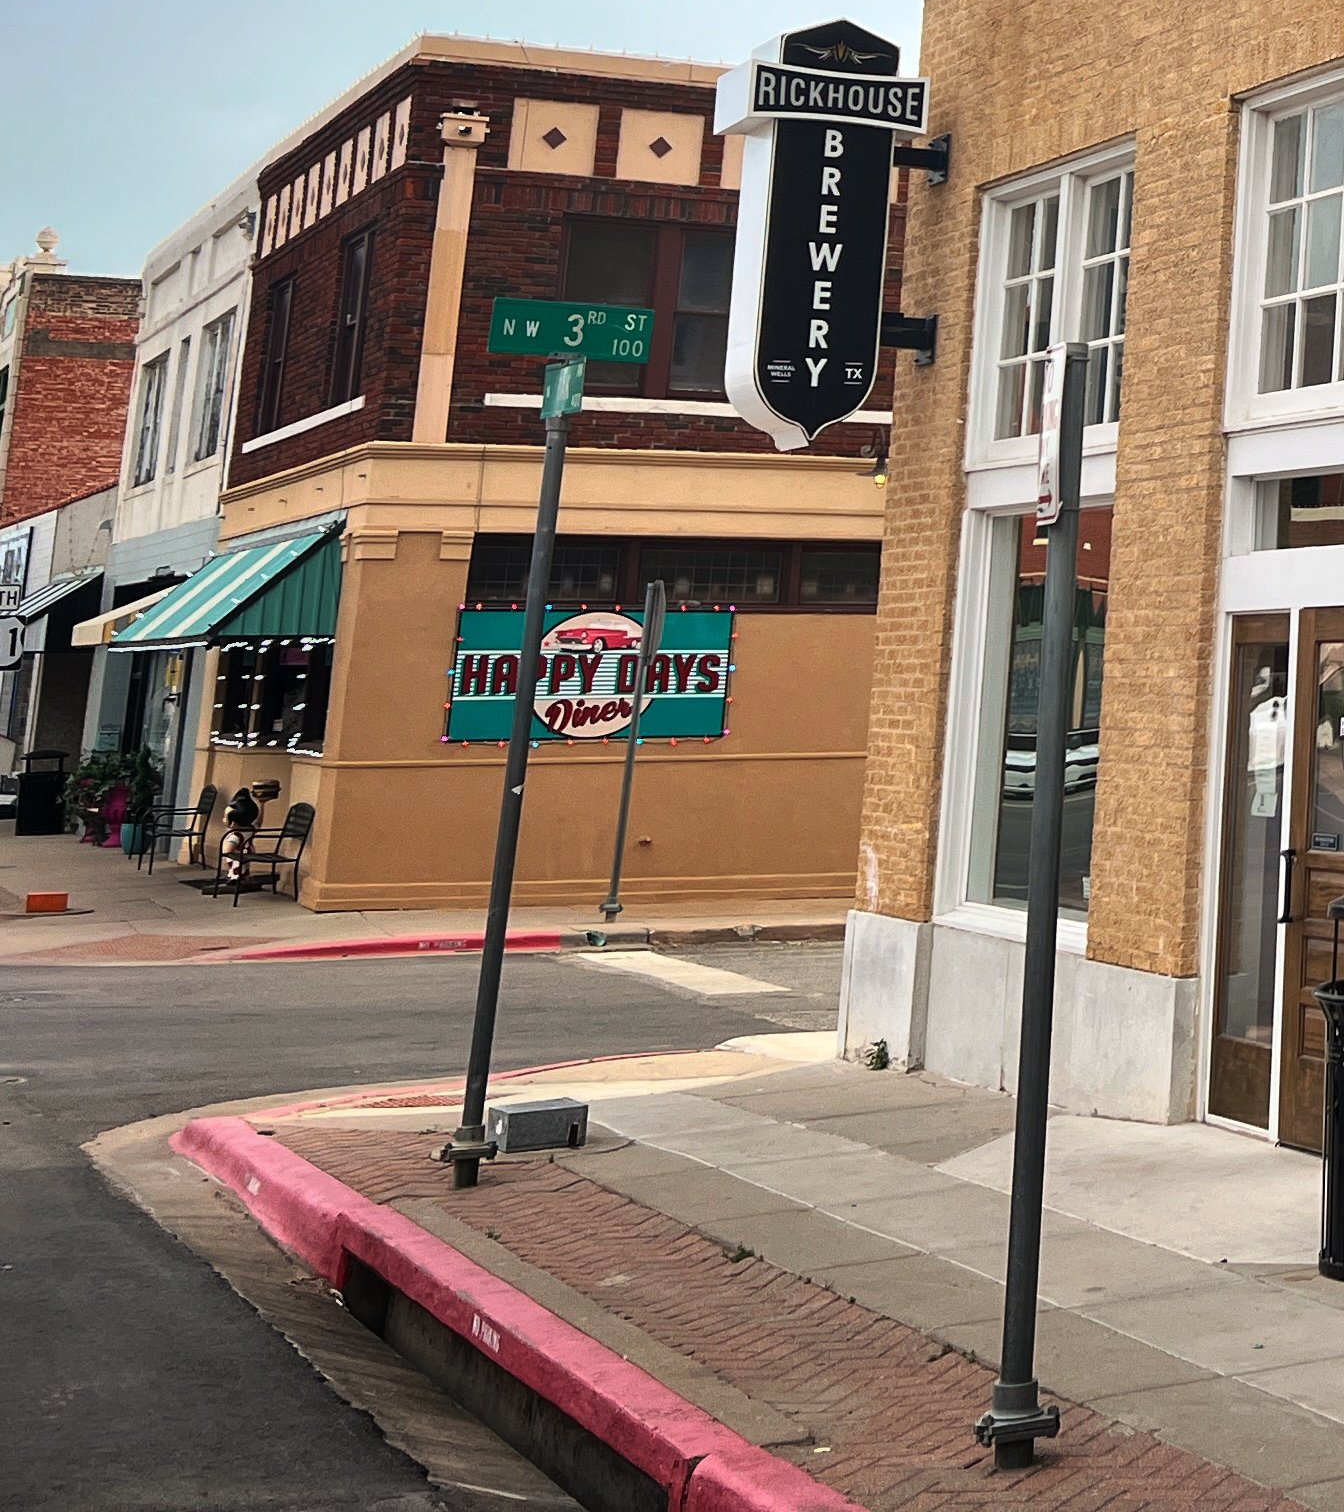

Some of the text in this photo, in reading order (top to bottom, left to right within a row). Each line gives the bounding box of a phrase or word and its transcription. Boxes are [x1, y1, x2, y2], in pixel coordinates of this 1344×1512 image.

[758, 71, 921, 121] RICKHOUSE
[804, 128, 844, 388] BREWERY
[624, 314, 648, 332] ST
[612, 338, 644, 357] 100
[767, 364, 796, 372] MINERAL
[844, 368, 863, 379] TX
[616, 653, 720, 694] DAYS
[545, 697, 638, 735] Diner
